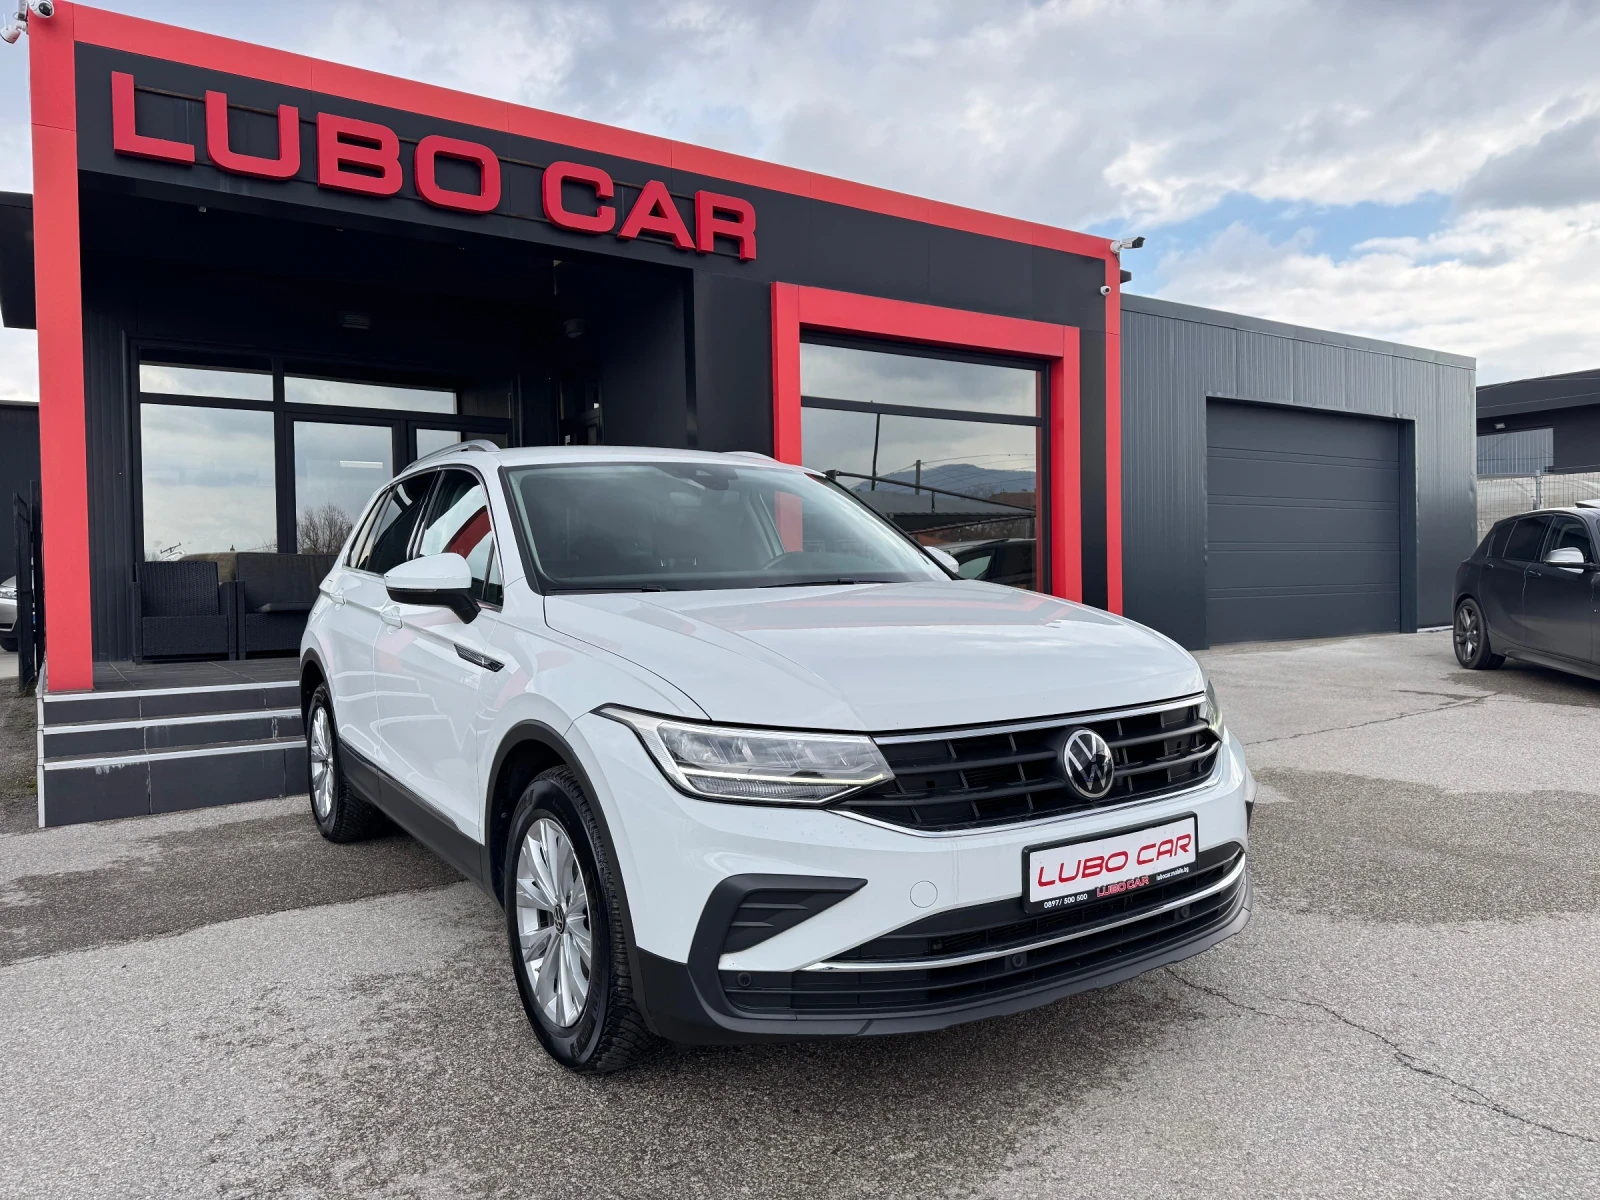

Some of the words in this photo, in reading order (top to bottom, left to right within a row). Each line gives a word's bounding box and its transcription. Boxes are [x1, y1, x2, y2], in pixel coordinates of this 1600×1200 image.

[111, 70, 502, 215] LUBO
[542, 160, 758, 262] CAR
[1037, 850, 1129, 887] LUBO
[1136, 833, 1192, 865] CAR
[1063, 895, 1076, 905] 500
[1096, 881, 1127, 898] LUBO
[1127, 875, 1150, 889] CAR
